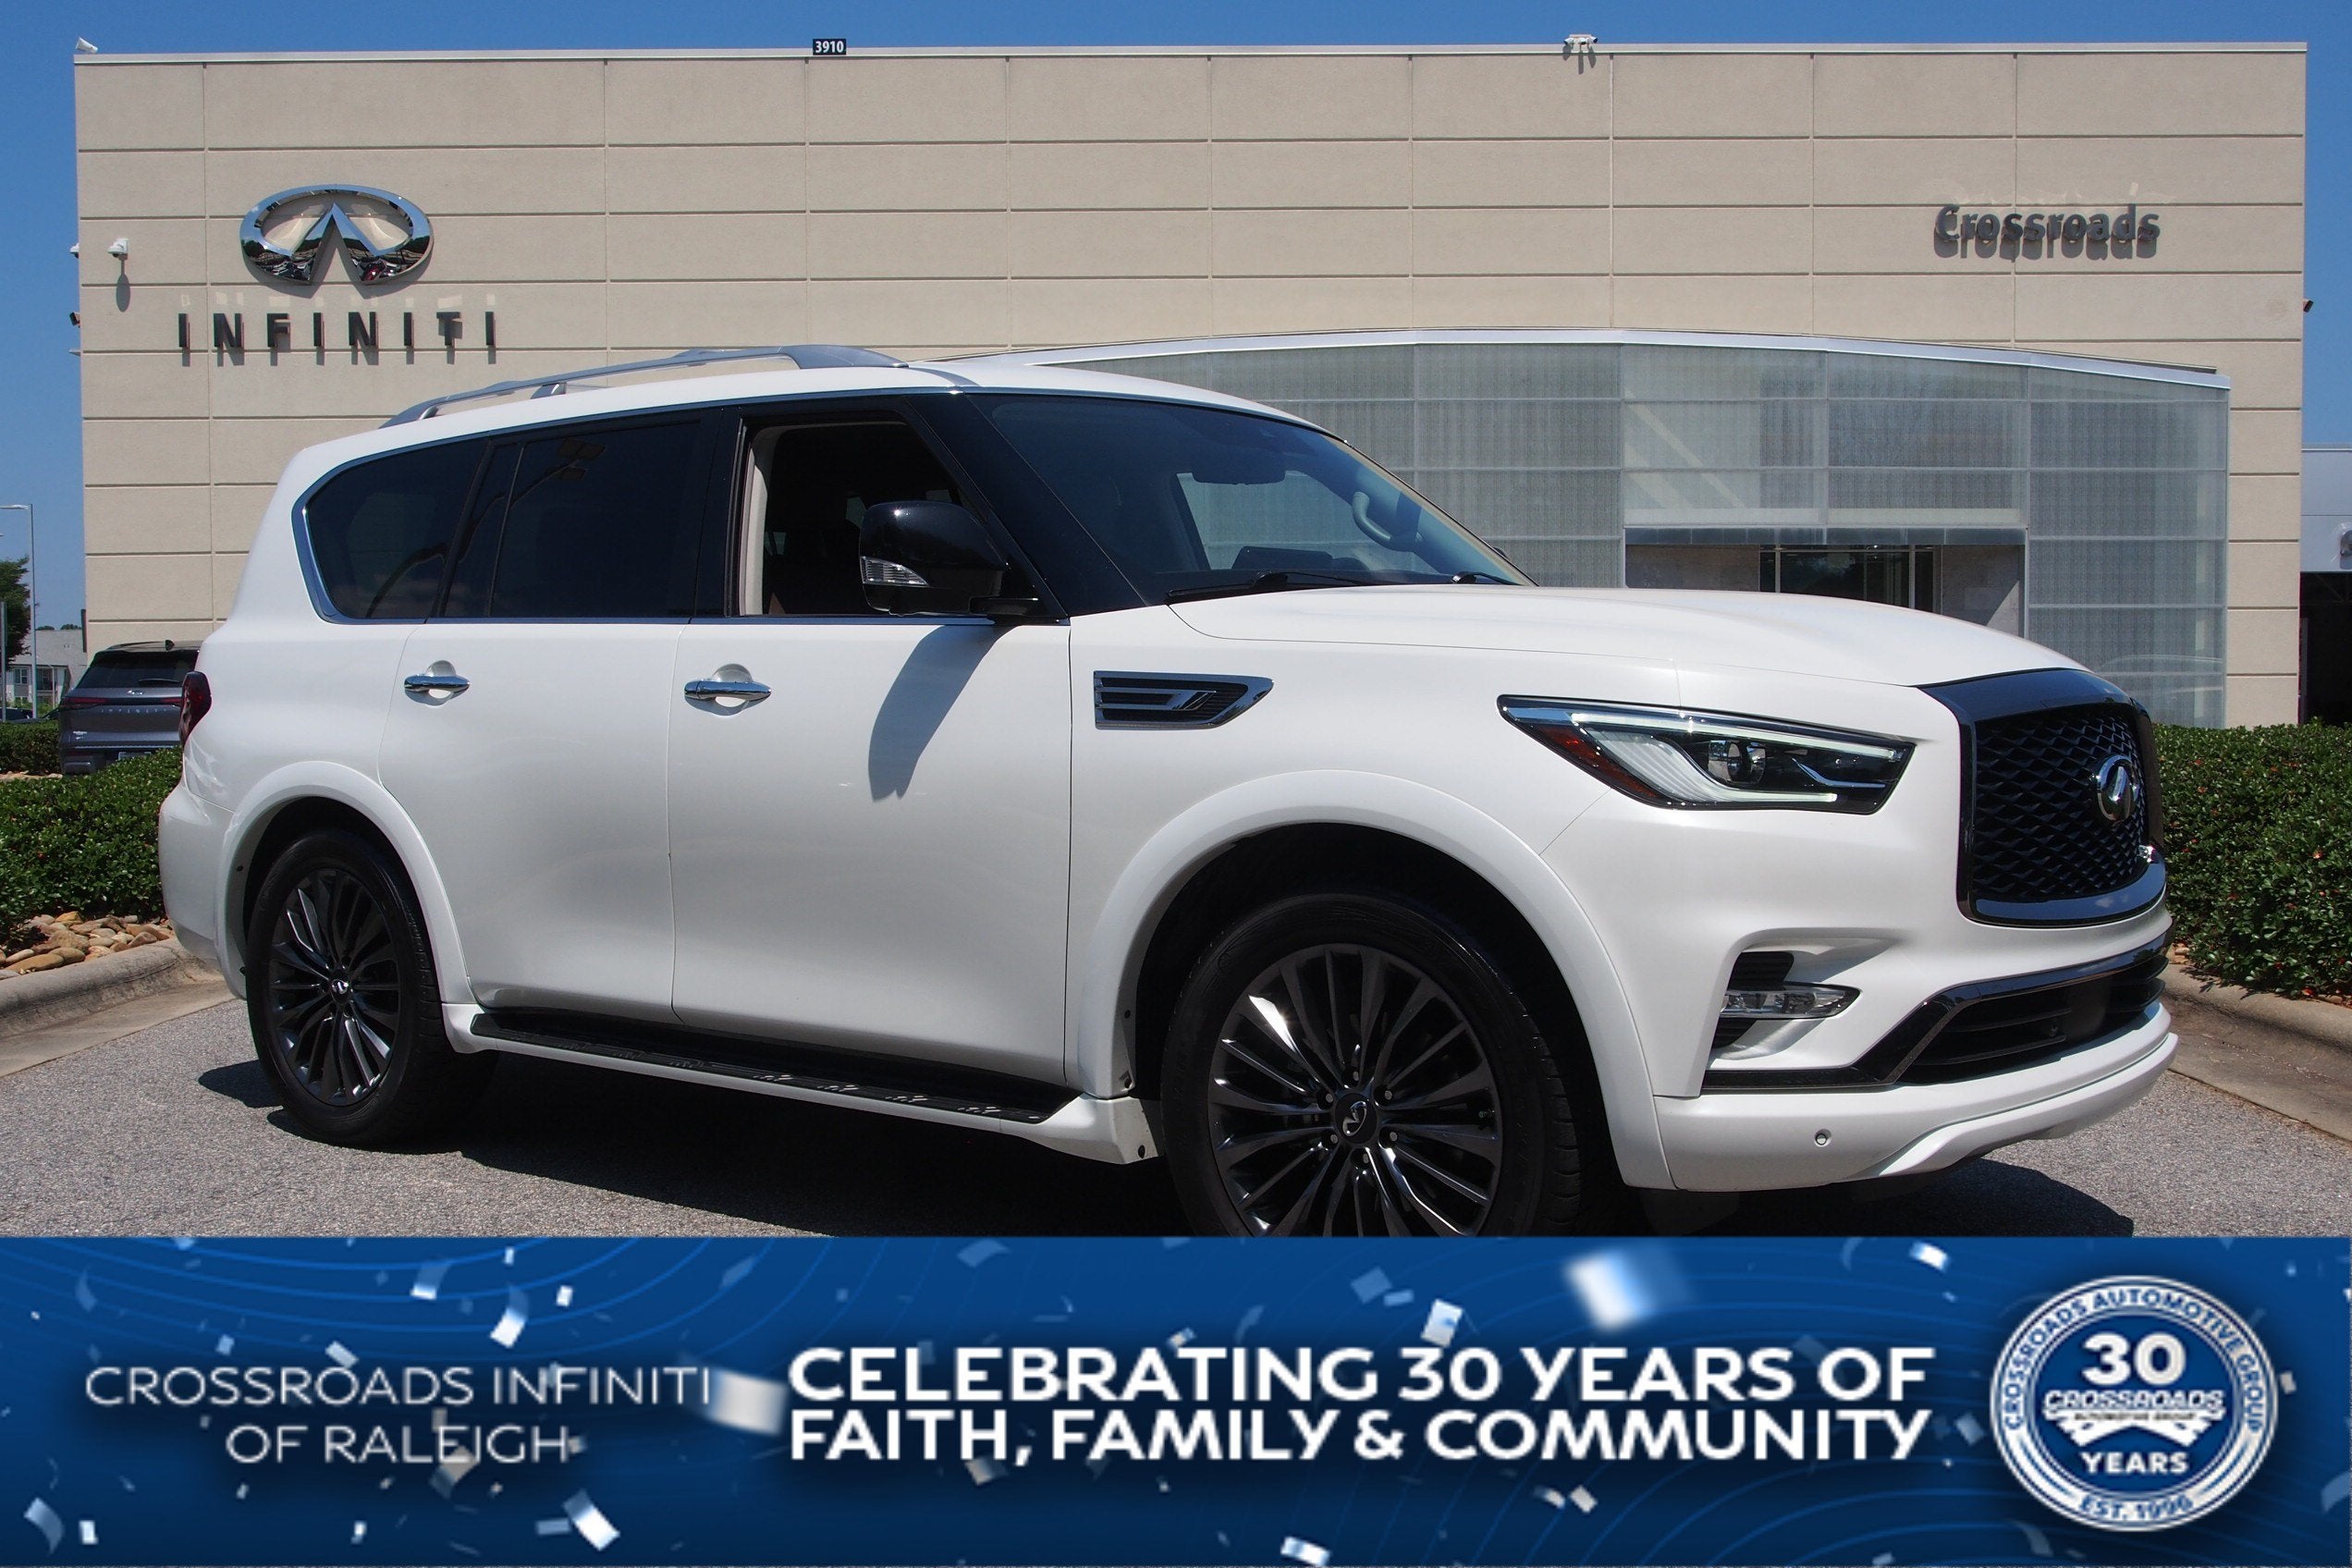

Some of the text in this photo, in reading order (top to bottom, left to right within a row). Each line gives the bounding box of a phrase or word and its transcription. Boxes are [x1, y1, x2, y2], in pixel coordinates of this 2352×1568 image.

[815, 40, 844, 54] 3910
[1935, 203, 2161, 242] Crossroads
[178, 312, 495, 348] INFINITI
